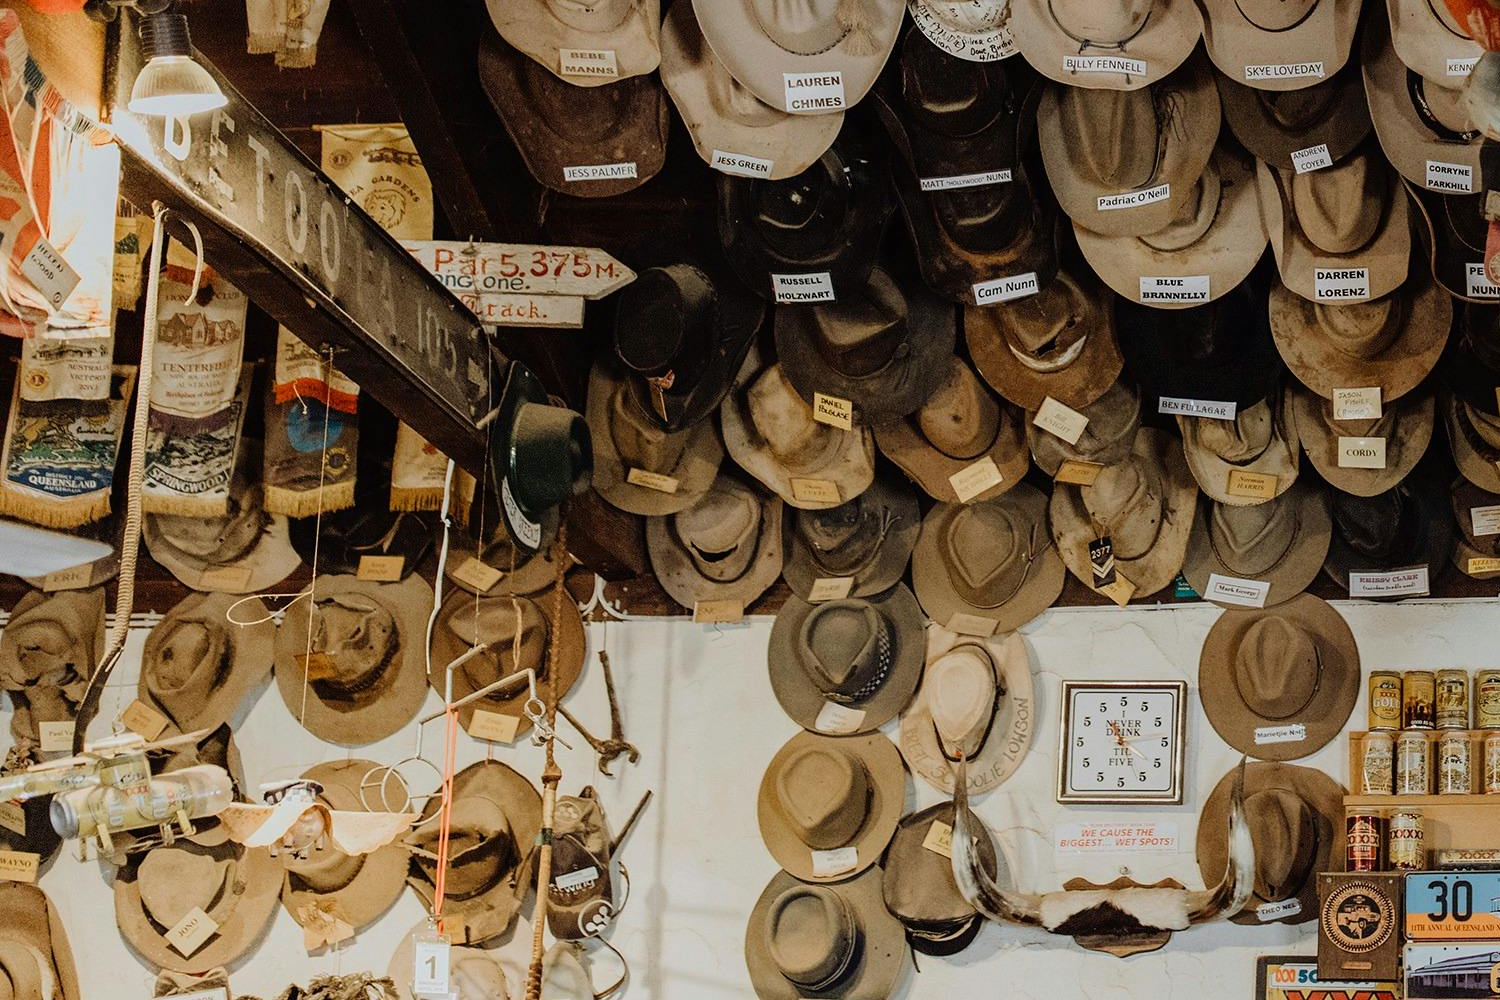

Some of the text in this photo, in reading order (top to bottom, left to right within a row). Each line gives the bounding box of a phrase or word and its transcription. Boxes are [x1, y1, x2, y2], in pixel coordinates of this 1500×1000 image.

[569, 51, 607, 61] BEBE
[564, 65, 615, 75] MANNS
[1066, 58, 1143, 73] BILLY FENNELL
[1247, 62, 1323, 77] SKYE LOVEDAY
[787, 75, 841, 88] LAUREN
[791, 95, 842, 109] CHIMES
[1292, 145, 1326, 161] ANDREW
[716, 156, 769, 174] JESS GREEN
[1300, 158, 1326, 171] COYER
[1428, 165, 1470, 177] CORRYNE
[567, 164, 635, 179] JESS PALMER
[921, 171, 1011, 190] MATT NUNN
[1428, 179, 1471, 192] PARKHILL
[372, 174, 421, 203] GARDENS
[1098, 187, 1169, 207] Padriac O'Neill
[434, 247, 488, 275] Par
[780, 276, 823, 286] RUSSELL
[1317, 270, 1365, 281] DARREN
[488, 274, 531, 291] one.
[976, 277, 1036, 299] Cam Nunn
[1156, 279, 1184, 287] BLUE
[777, 289, 830, 299] HOLZWART
[1142, 290, 1207, 300] BRANNELLY
[1318, 286, 1366, 297] LORENZ
[1161, 400, 1177, 410] BEN
[1346, 448, 1377, 458] CORDY
[28, 475, 97, 489] QUEENSLAND
[151, 468, 226, 494] SPRINGWOOD
[1091, 543, 1111, 560] 2377
[1105, 720, 1142, 728] NEVER
[1105, 728, 1141, 736] DRINK
[1108, 758, 1134, 766] FIVE
[1081, 829, 1097, 837] WE
[1136, 828, 1154, 836] THE
[1115, 838, 1137, 846] WET
[1460, 850, 1500, 861] XXXX
[1427, 880, 1473, 922] 30
[1261, 907, 1281, 915] THEO
[177, 918, 199, 938] JONO
[1428, 924, 1496, 932] ANNUAL QUEENSLAND
[425, 956, 437, 979] 1
